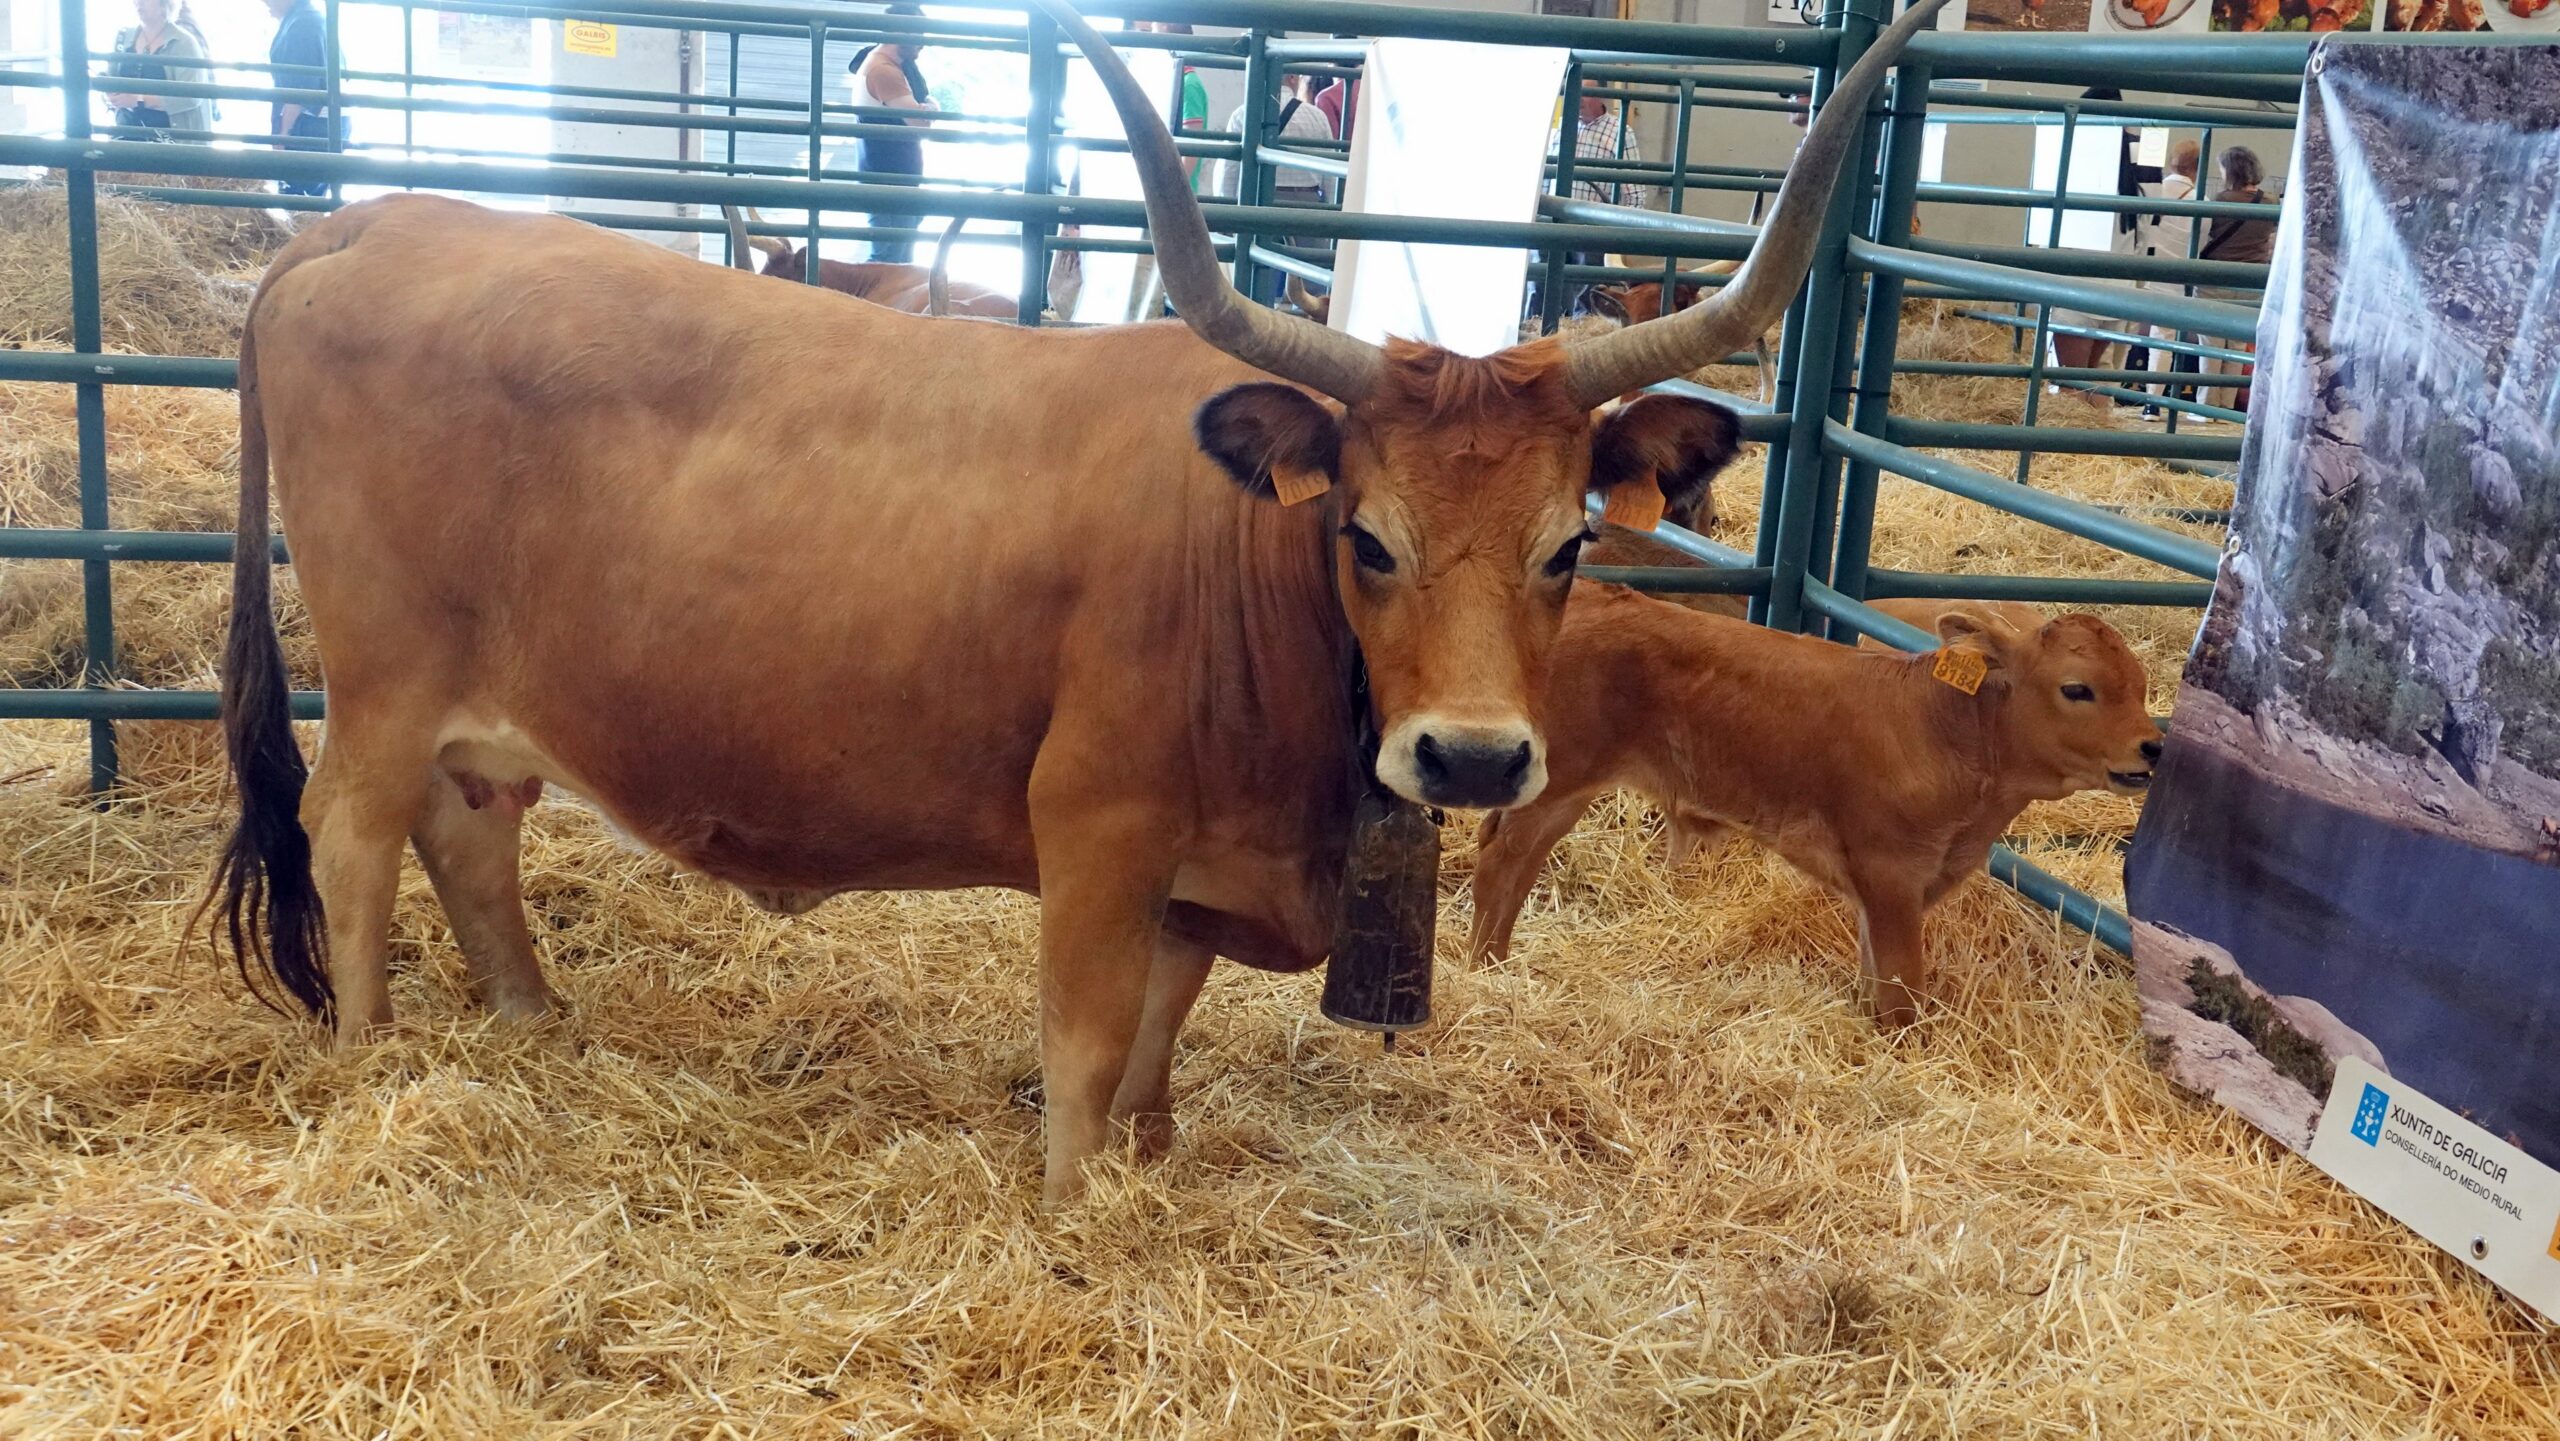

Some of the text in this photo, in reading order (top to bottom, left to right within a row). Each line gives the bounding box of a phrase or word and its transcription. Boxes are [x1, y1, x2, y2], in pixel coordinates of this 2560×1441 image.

[1936, 662, 1982, 692] 9784
[2385, 1130, 2523, 1221] CONSELLERÍA DO MEDIO RURAL
[2391, 1104, 2508, 1184] XUNTA DE GALICIA
